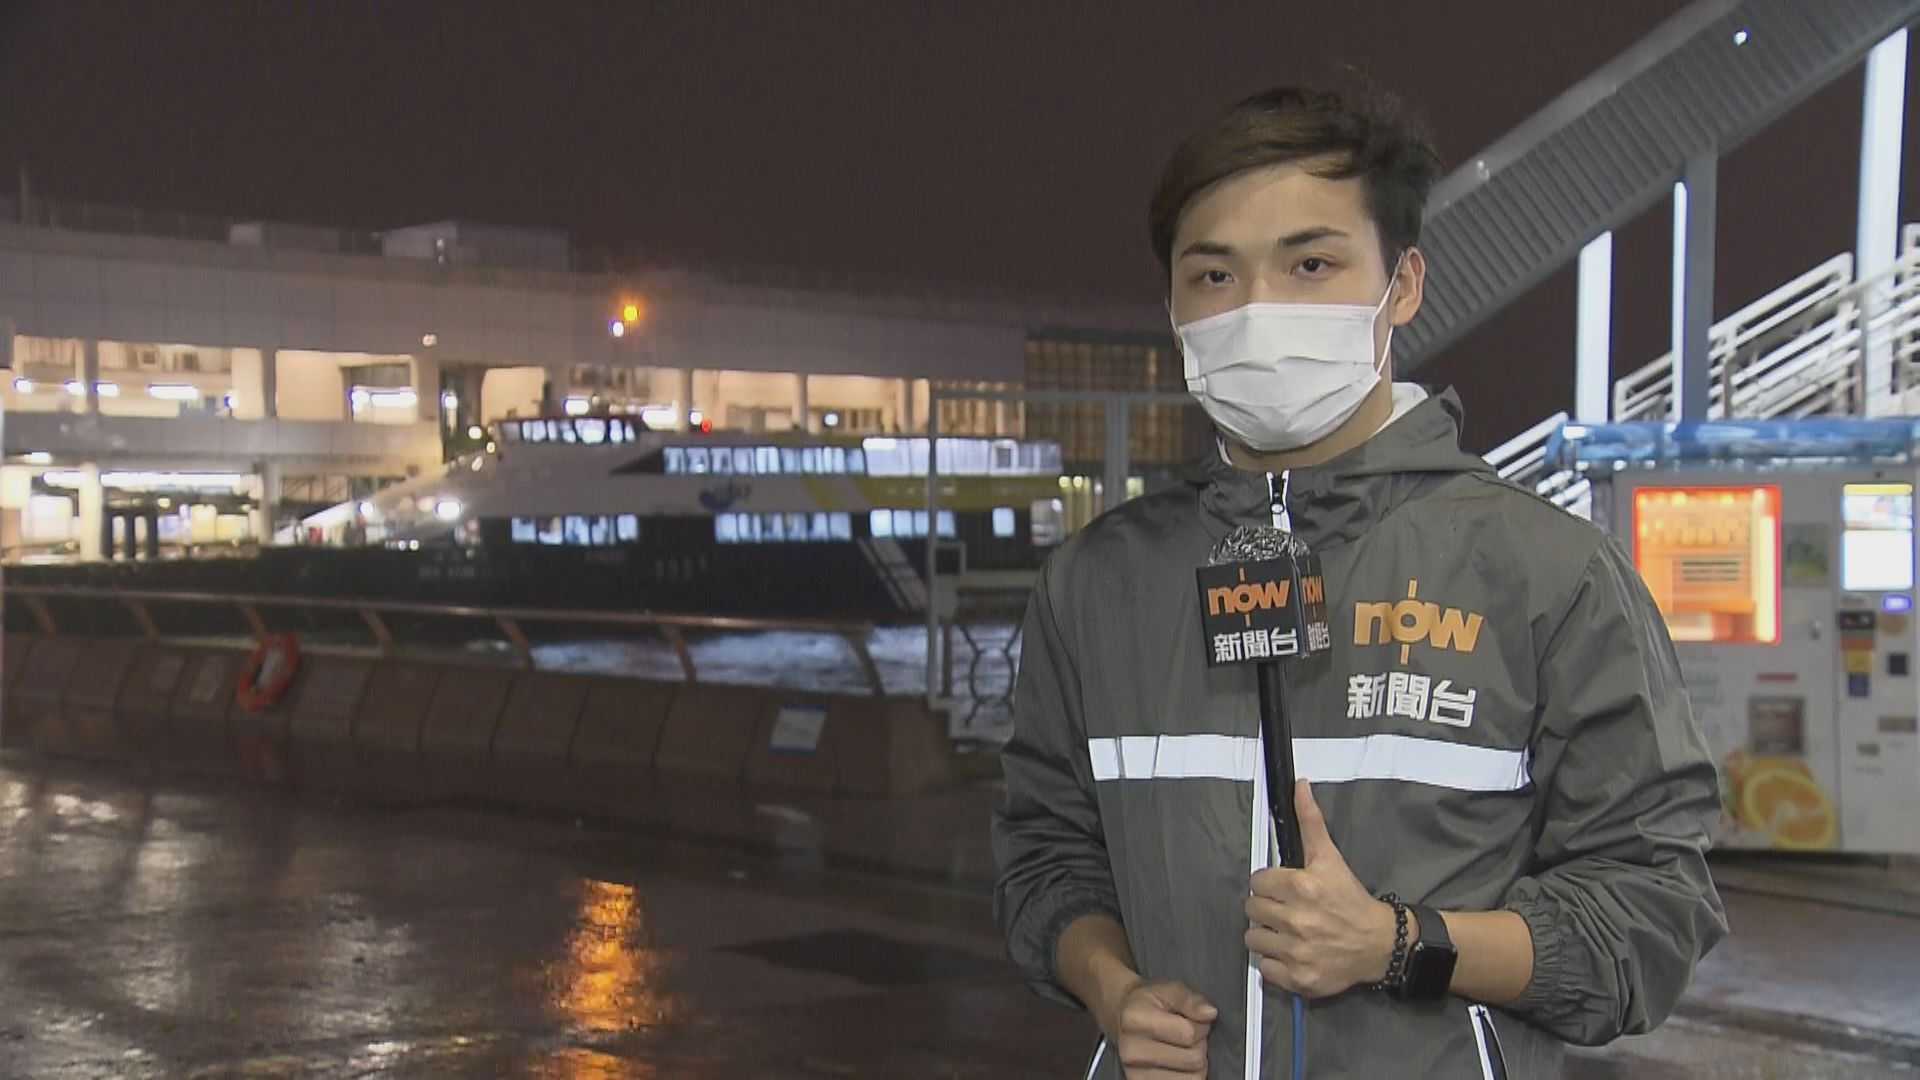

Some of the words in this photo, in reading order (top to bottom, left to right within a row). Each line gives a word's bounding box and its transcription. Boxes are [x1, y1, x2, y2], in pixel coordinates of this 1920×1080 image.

[1207, 579, 1290, 615] now
[1213, 626, 1299, 663] 新聞台
[1353, 599, 1483, 653] now
[1346, 672, 1477, 727] 新聞台
